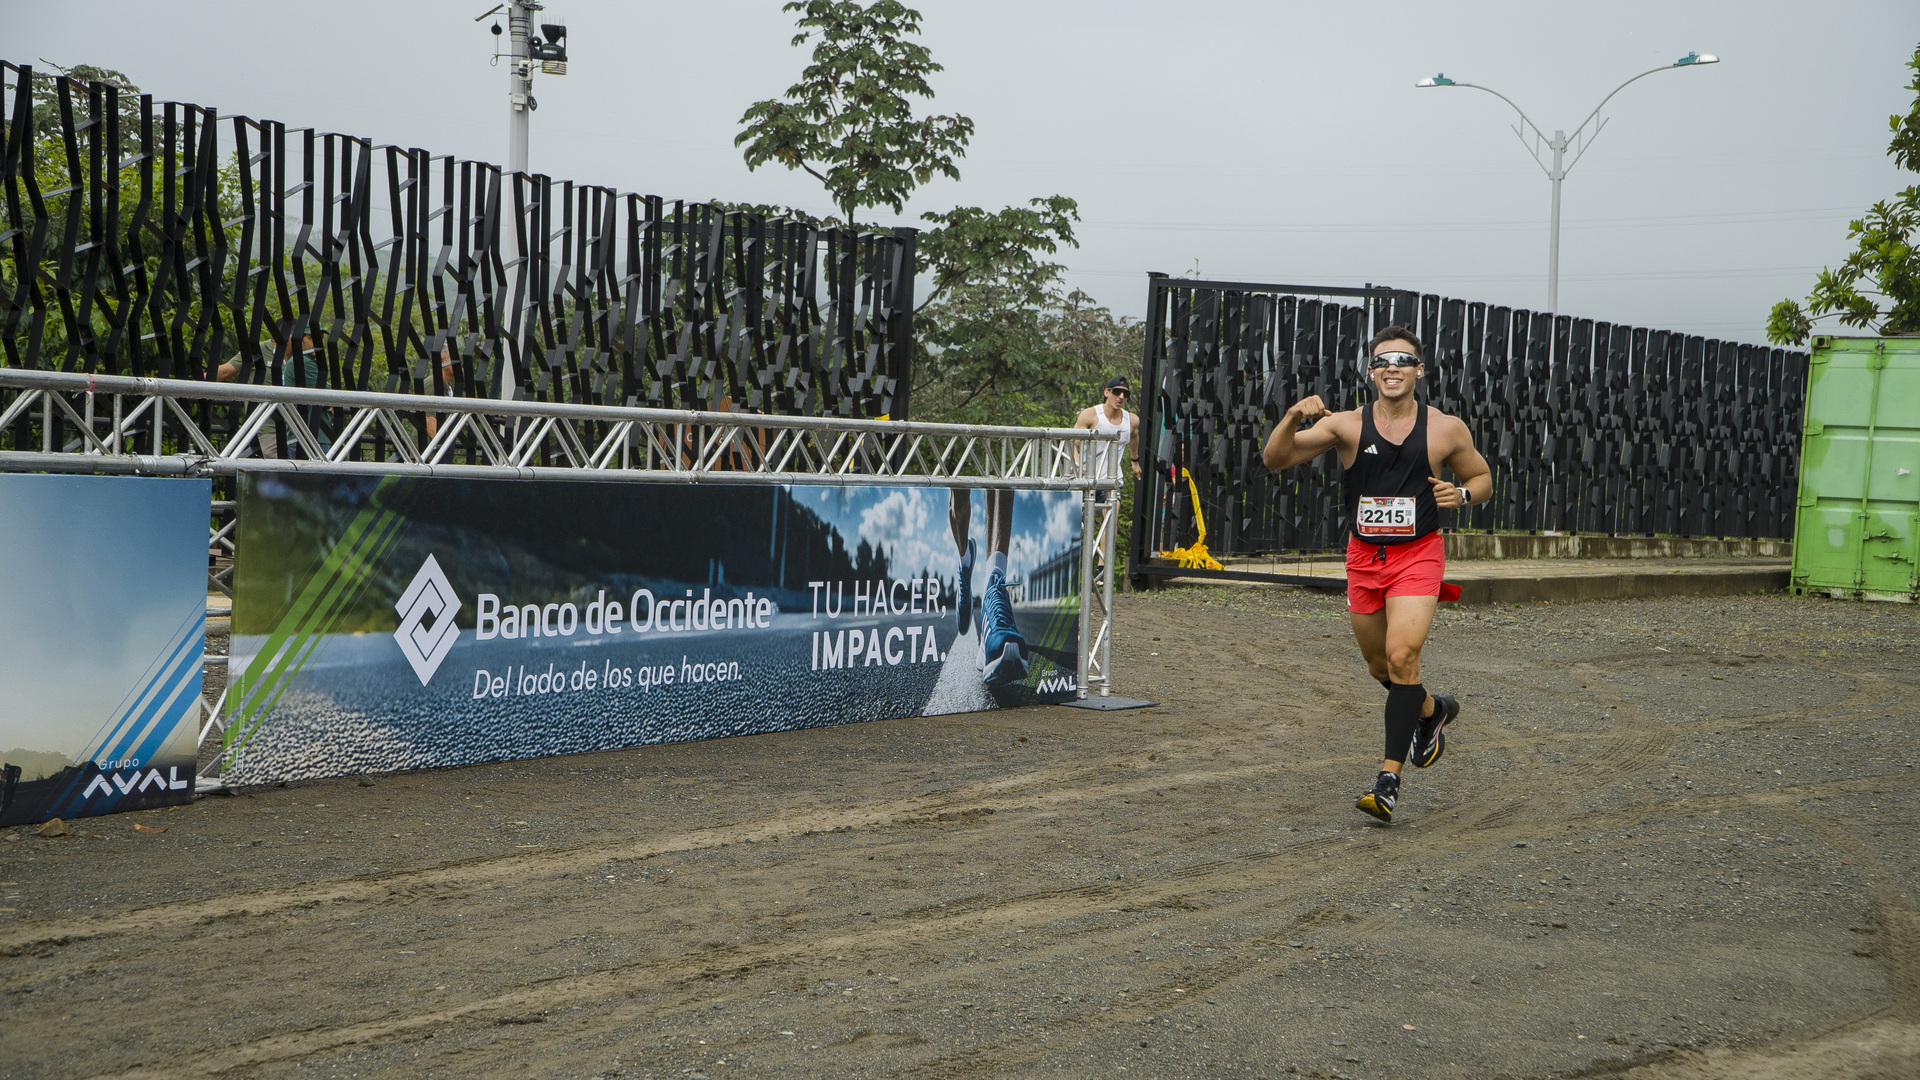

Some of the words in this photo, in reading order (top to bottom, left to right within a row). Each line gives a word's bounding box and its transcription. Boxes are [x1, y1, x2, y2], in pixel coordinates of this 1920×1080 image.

[1364, 509, 1405, 524] 2215
[476, 593, 578, 641] Banco
[585, 589, 624, 635] de
[630, 587, 772, 633] Occidente
[808, 580, 843, 619] TU
[854, 578, 947, 619] HACER,
[811, 625, 947, 671] IMPACTA.
[473, 665, 512, 700] Del
[517, 662, 566, 696] lado
[570, 660, 598, 691] de
[603, 658, 633, 689] los
[638, 664, 675, 694] que
[680, 654, 743, 684] hacen.
[1036, 675, 1077, 695] AVAL
[1041, 669, 1058, 677] Grupo
[98, 758, 140, 771] Grupo
[82, 766, 188, 800] AVAL
